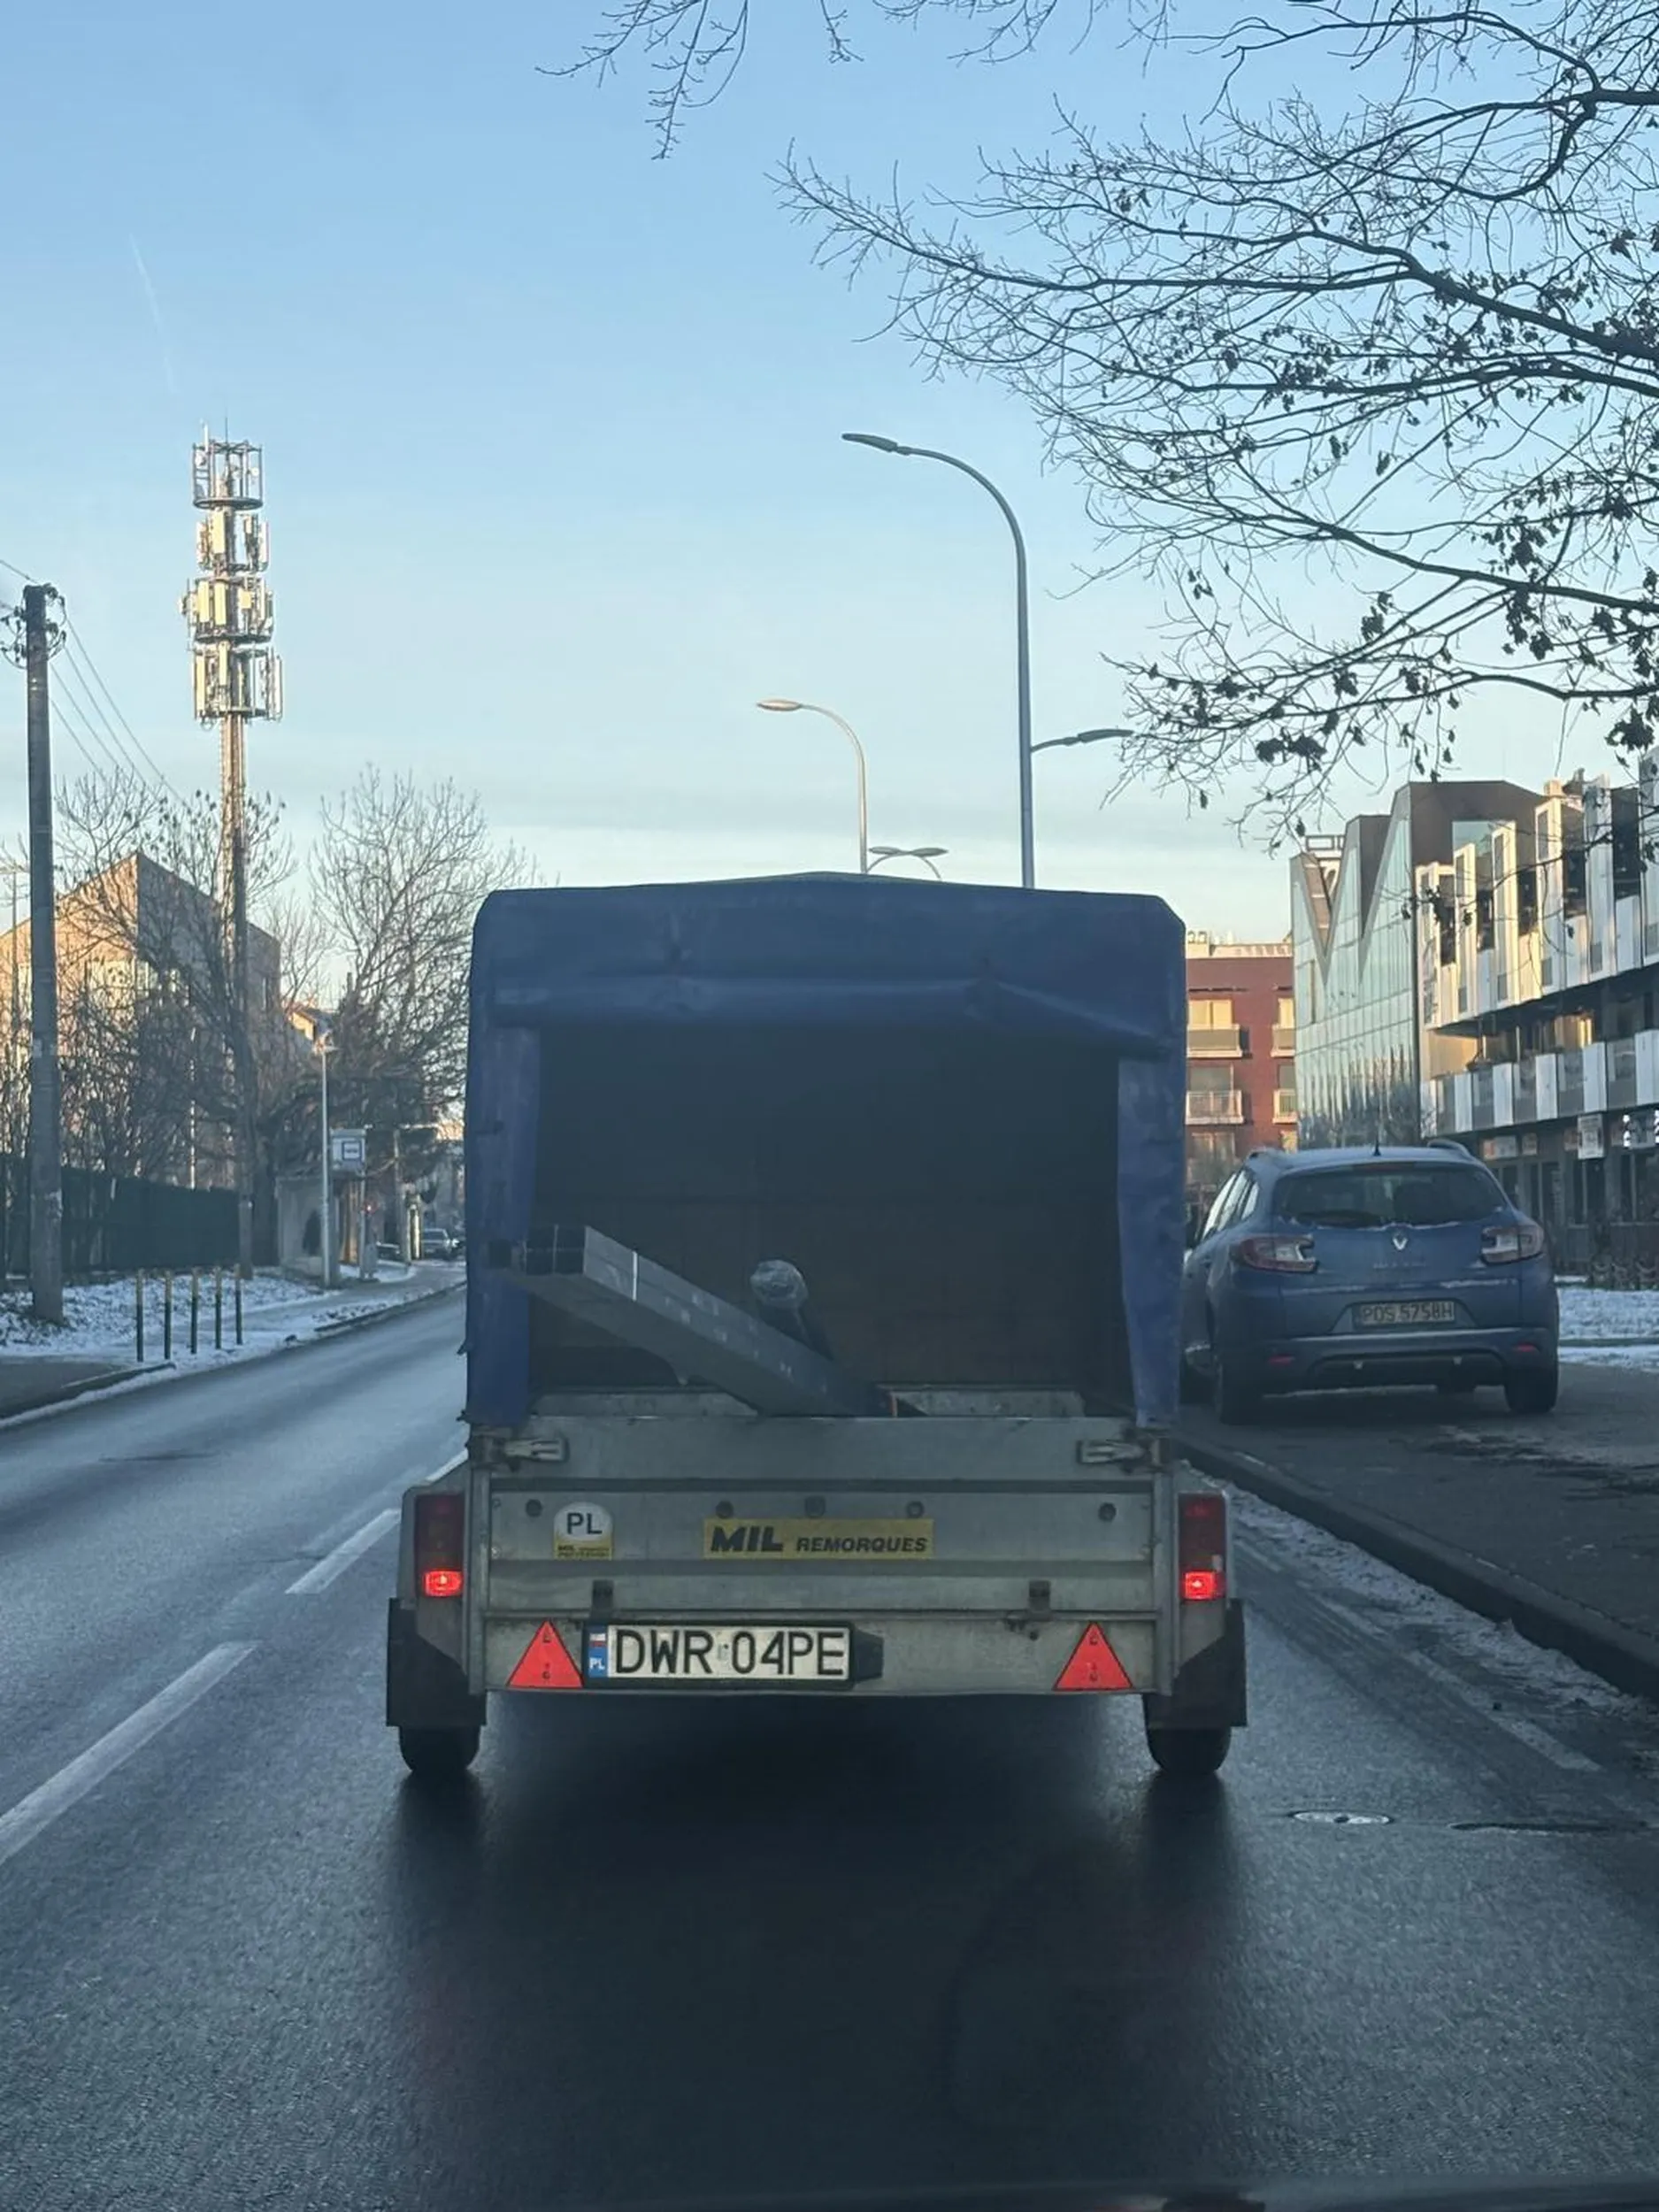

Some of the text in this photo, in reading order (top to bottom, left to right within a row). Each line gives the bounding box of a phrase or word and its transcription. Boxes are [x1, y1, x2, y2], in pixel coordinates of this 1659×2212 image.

[567, 1512, 603, 1535] PL
[710, 1525, 928, 1553] MIL REMORQUES
[588, 1657, 606, 1671] PL
[616, 1629, 844, 1676] DWR 04PE
